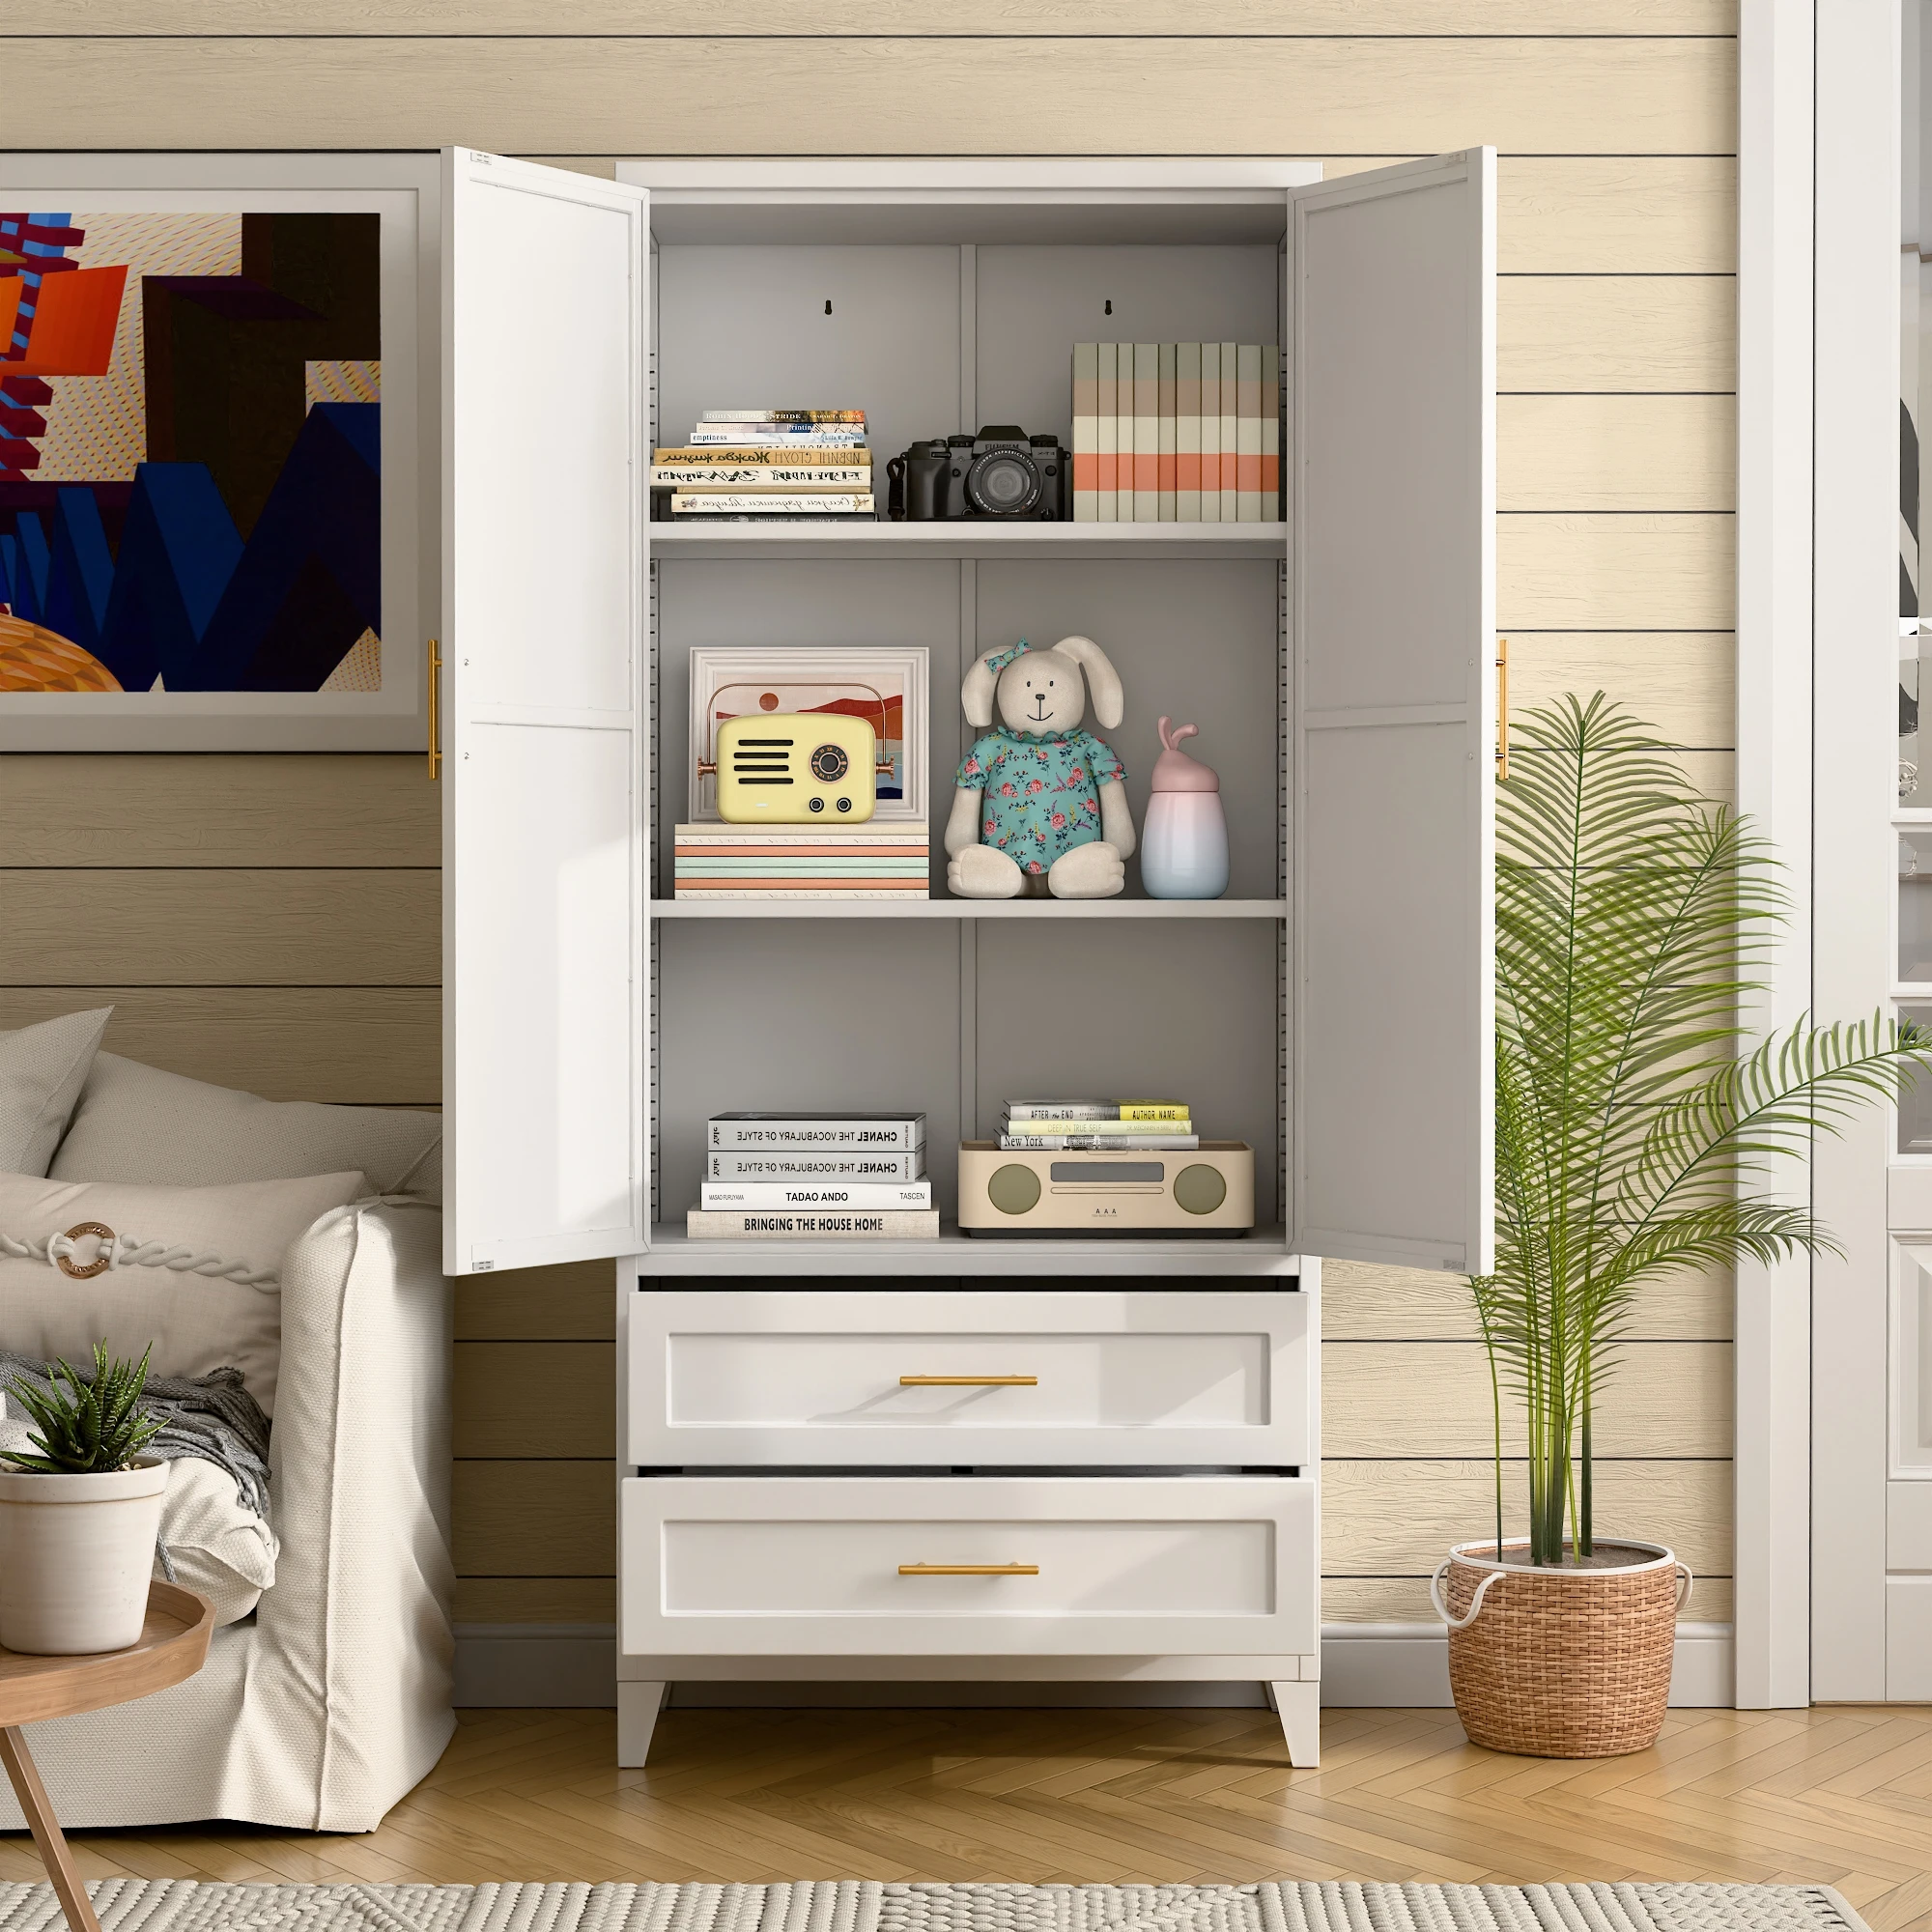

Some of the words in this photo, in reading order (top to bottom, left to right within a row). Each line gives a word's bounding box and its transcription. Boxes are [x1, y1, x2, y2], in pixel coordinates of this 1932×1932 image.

[1031, 1110, 1049, 1120] AFTER
[1061, 1110, 1074, 1120] END
[1132, 1110, 1155, 1120] AUTHOR
[1158, 1110, 1176, 1120] NAME
[1089, 1123, 1102, 1133] SELF
[1004, 1136, 1023, 1147] New
[1025, 1136, 1043, 1147] York
[785, 1192, 819, 1202] TADAO
[820, 1192, 848, 1202] ANDO
[744, 1218, 793, 1231] BRINGING
[796, 1218, 816, 1231] THE
[818, 1218, 852, 1231] HOUSE
[854, 1218, 883, 1231] HOME
